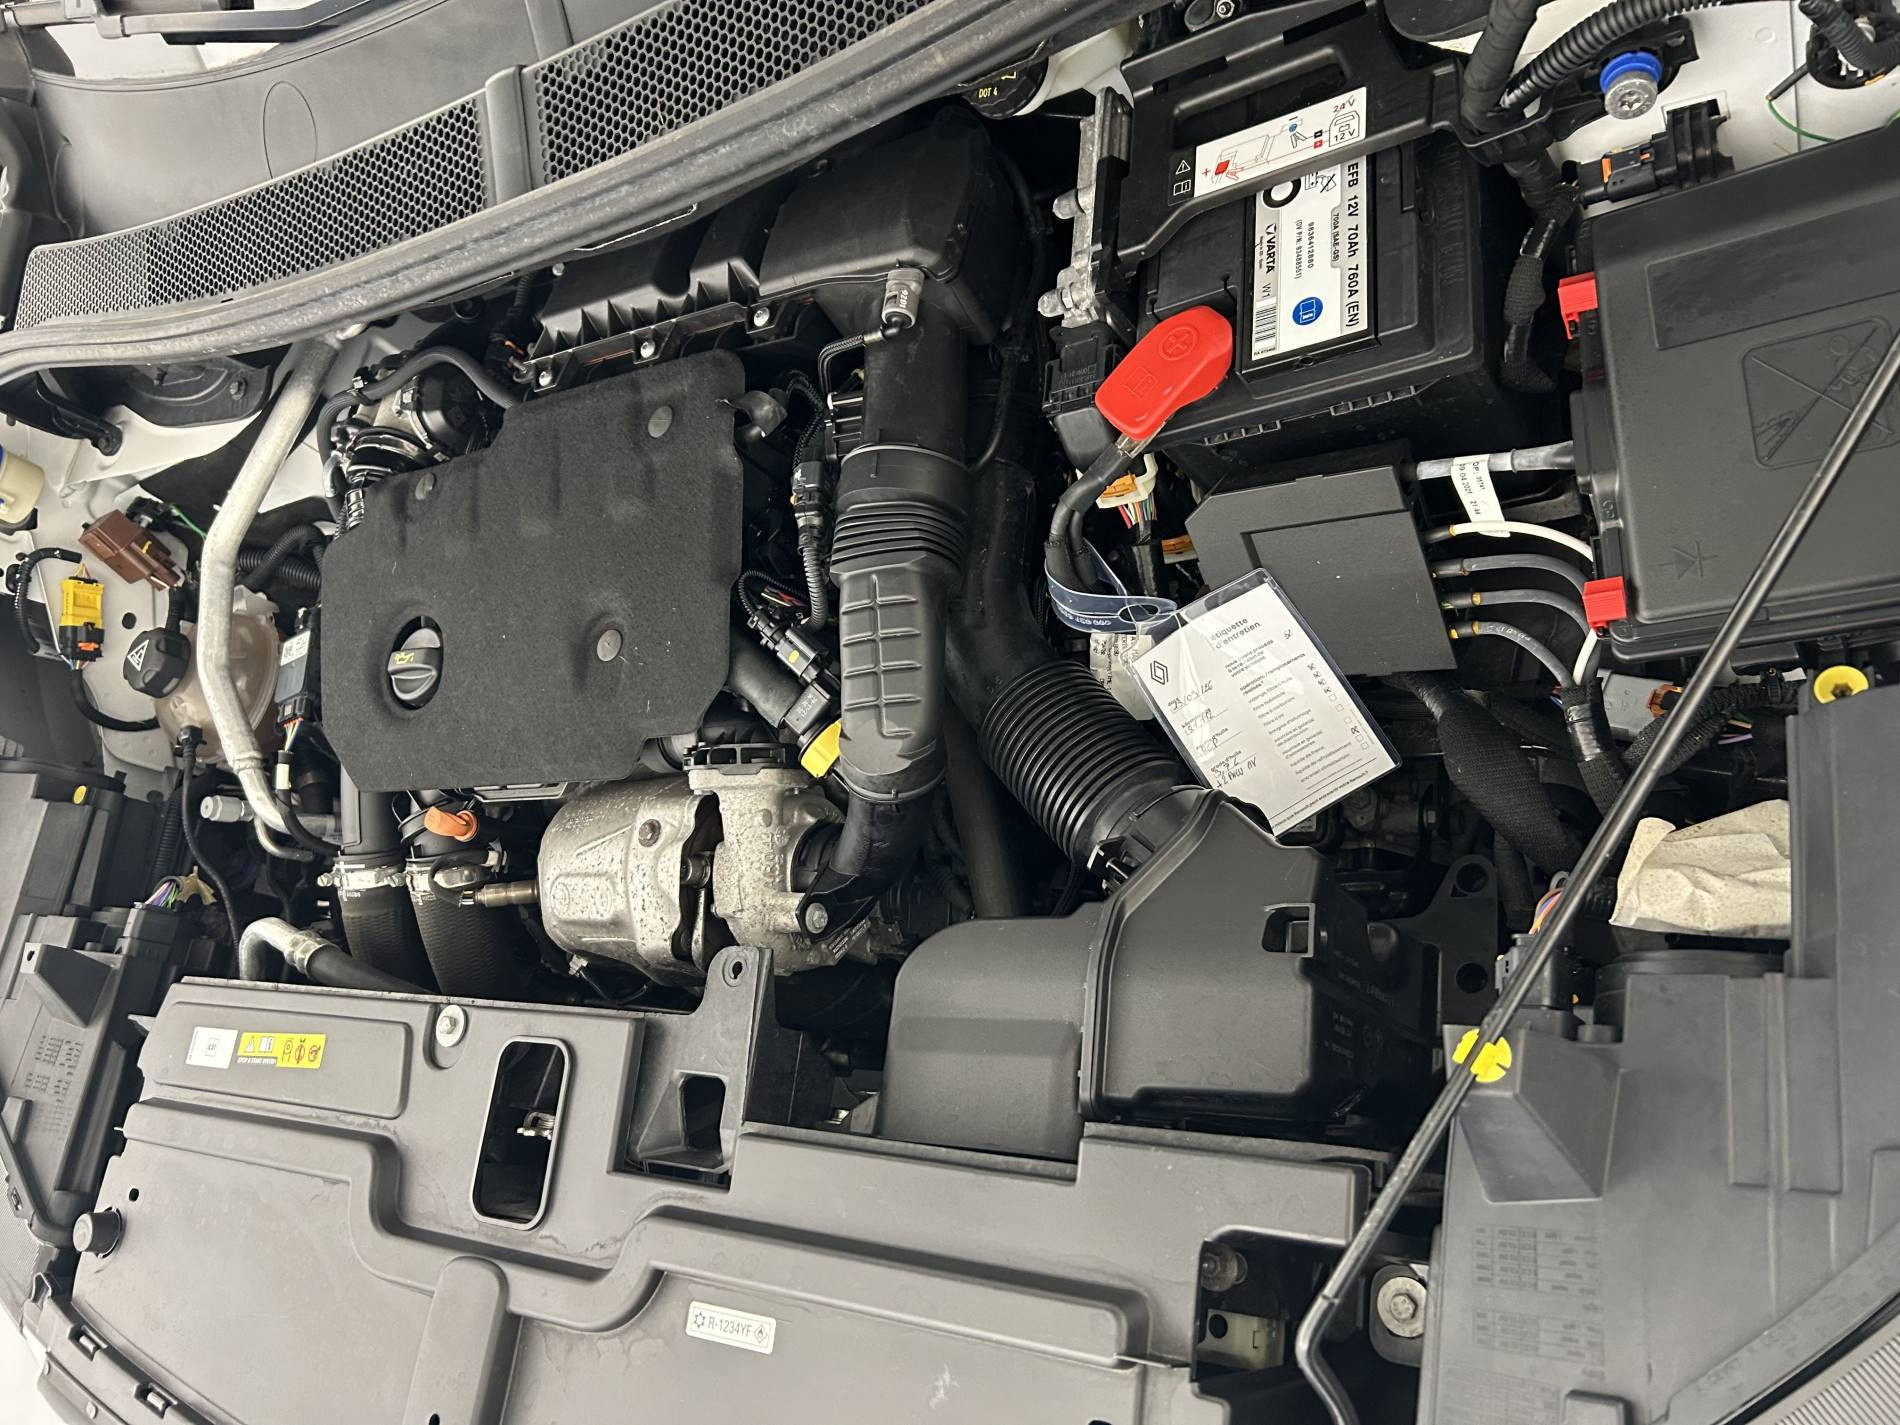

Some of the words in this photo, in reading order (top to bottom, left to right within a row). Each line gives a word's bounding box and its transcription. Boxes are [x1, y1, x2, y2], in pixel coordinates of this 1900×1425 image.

[978, 87, 992, 99] DOT
[993, 87, 998, 97] 4
[1347, 162, 1359, 188] EFB
[1347, 194, 1359, 217] 12V
[1332, 212, 1340, 230] 700A
[1307, 221, 1315, 269] 9836412880
[1347, 224, 1359, 258] 70Ah
[1265, 235, 1276, 275] VARTA
[1261, 282, 1272, 299] W1
[1347, 264, 1359, 299] 760A
[899, 289, 908, 307] 1026
[1345, 300, 1360, 328] (EN)
[1216, 621, 1261, 649] d'entretien
[707, 1316, 753, 1338] R-1234YF
